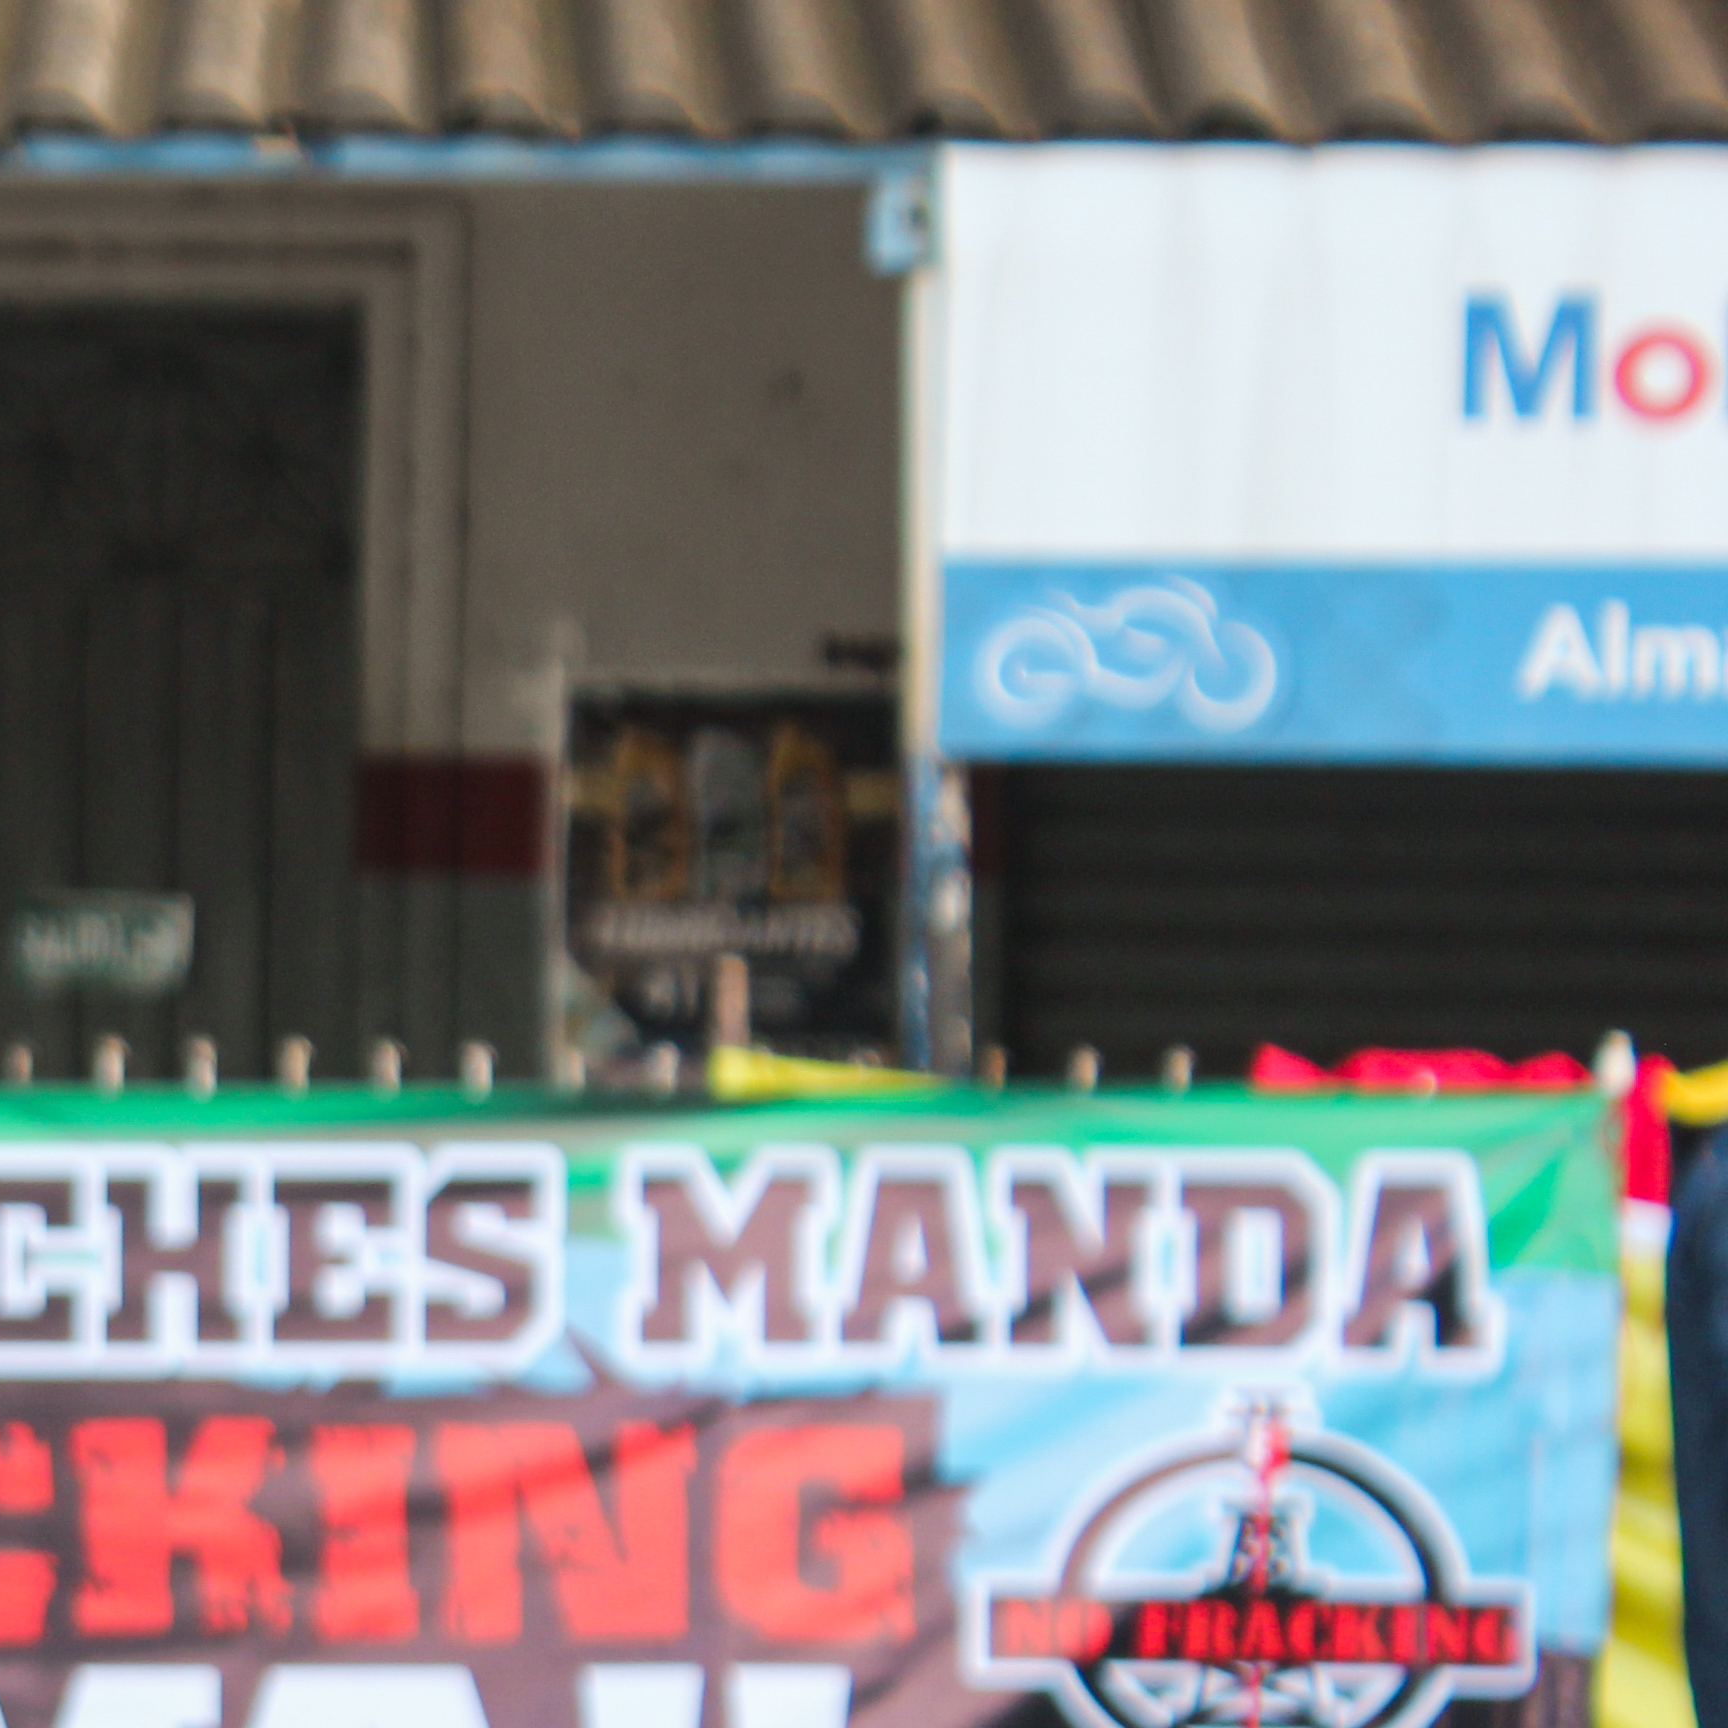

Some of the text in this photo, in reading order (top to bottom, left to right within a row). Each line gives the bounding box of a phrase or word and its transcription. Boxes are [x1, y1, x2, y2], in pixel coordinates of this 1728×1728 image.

[1461, 288, 1728, 427] Mo
[1518, 598, 1728, 702] Alm
[624, 1148, 1498, 1372] MANDA
[996, 1600, 1519, 1666] NO FRACKING
